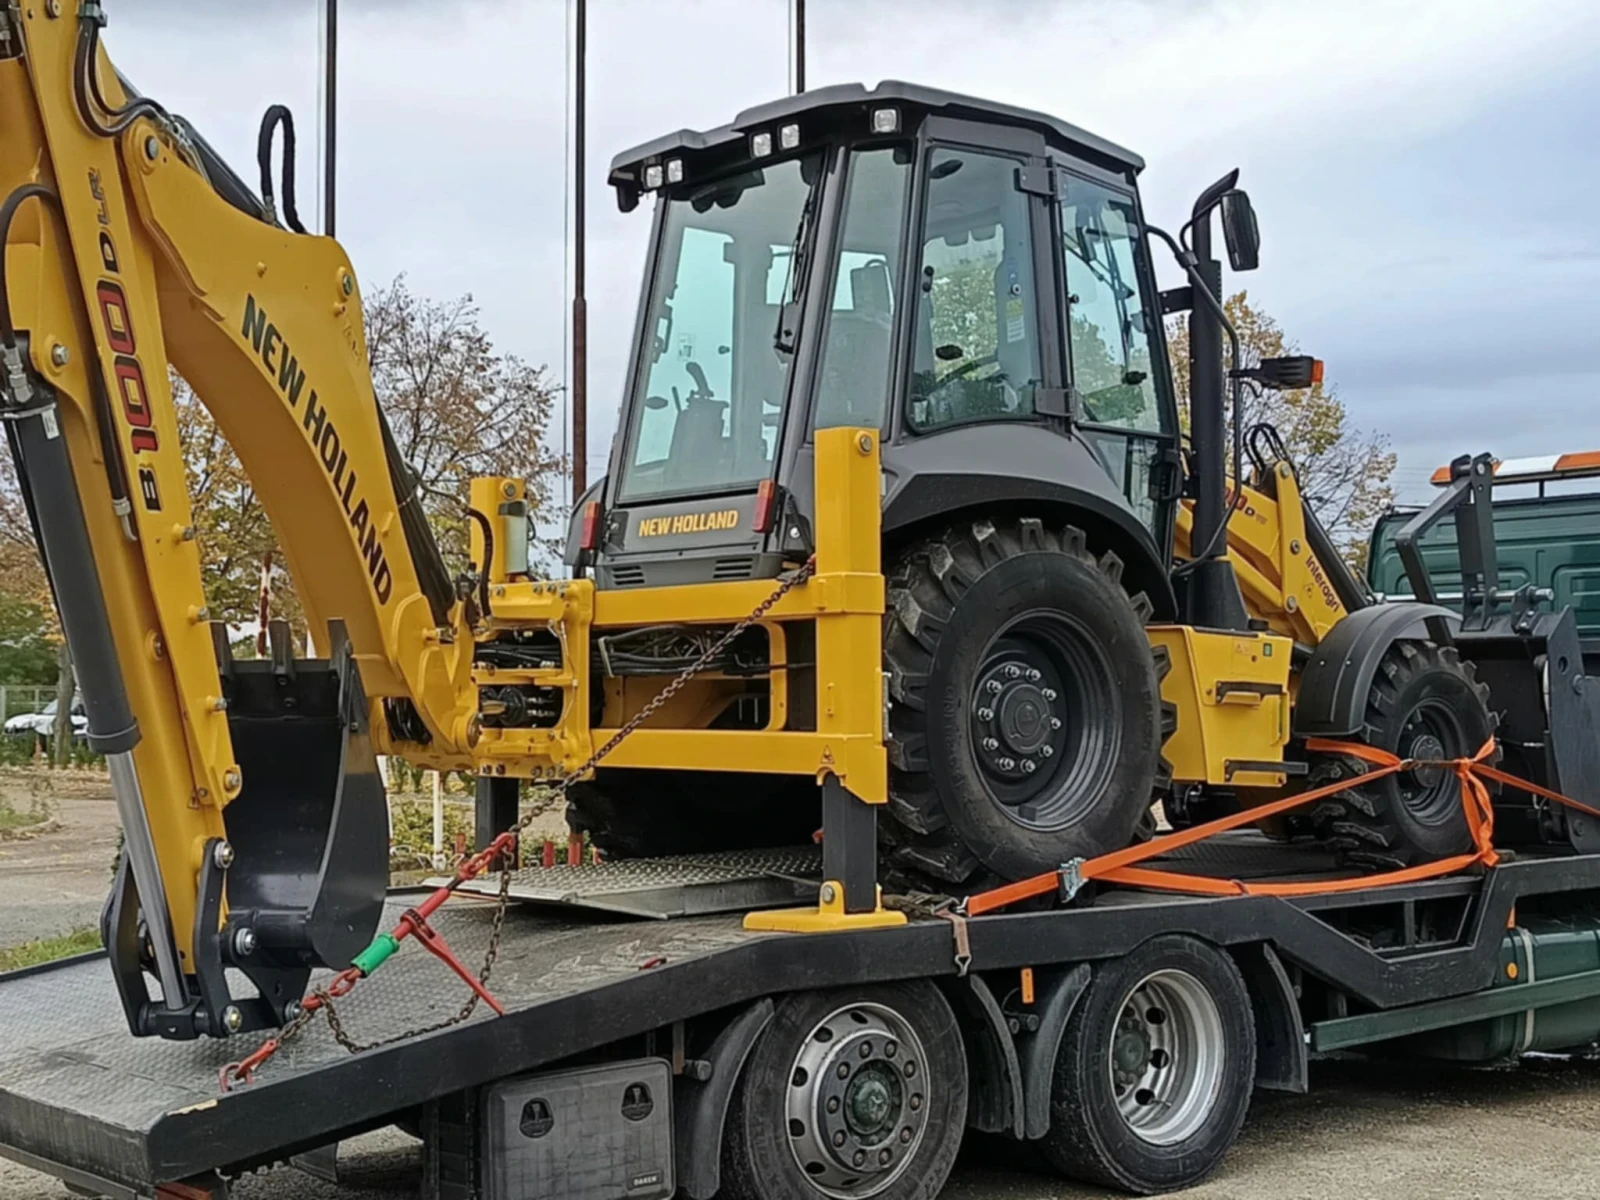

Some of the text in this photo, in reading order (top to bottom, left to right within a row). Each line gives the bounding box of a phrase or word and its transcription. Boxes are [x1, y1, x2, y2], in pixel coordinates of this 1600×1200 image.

[241, 292, 393, 606] NEW HOLLAND
[638, 510, 739, 537] NEW HOLLAND
[1305, 555, 1340, 613] Interagri
